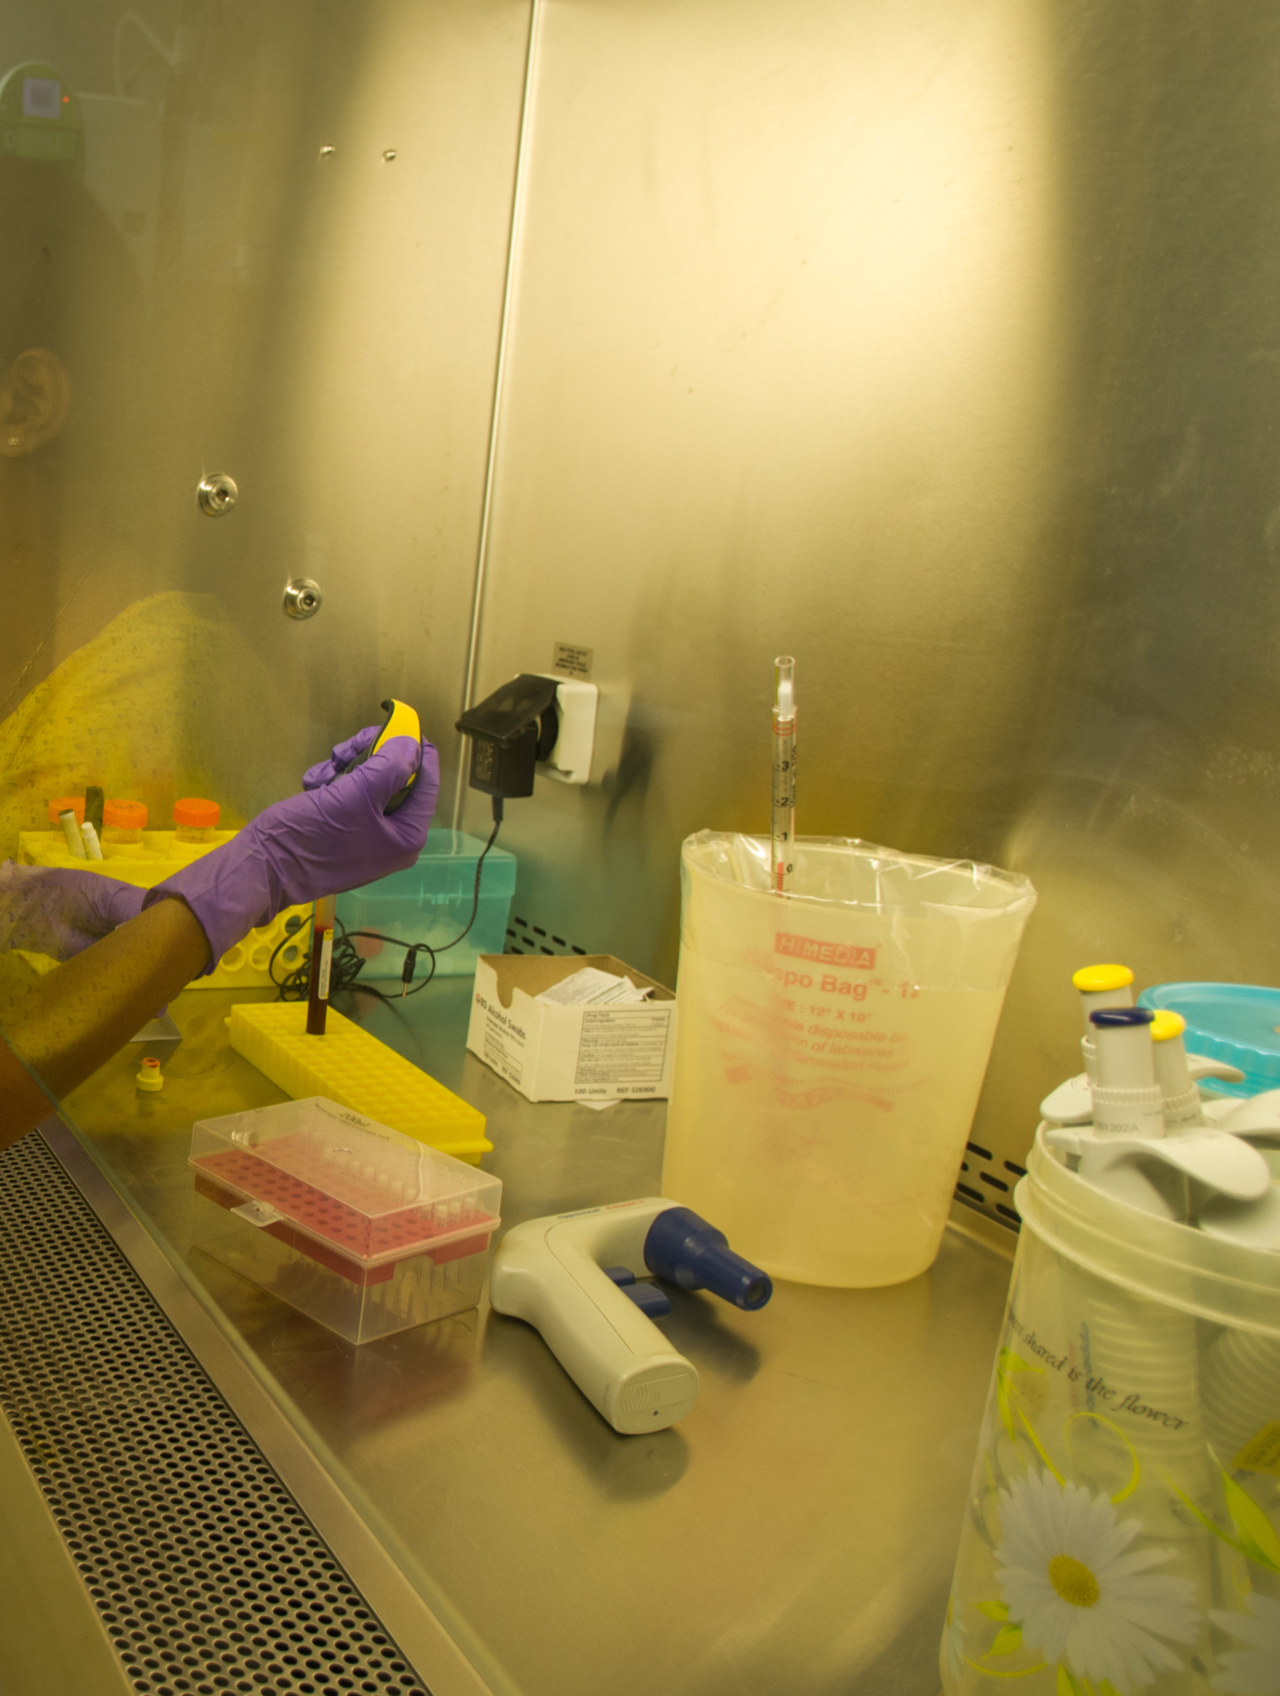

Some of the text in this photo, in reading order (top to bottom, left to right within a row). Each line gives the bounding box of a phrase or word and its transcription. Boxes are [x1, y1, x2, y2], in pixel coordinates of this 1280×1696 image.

[779, 936, 872, 966] HIMEDIA
[487, 1003, 507, 1026] Alcohol
[507, 1019, 526, 1040] Swabs
[807, 1023, 887, 1043] disposable
[588, 1087, 607, 1095] Units
[616, 1086, 629, 1094] REF
[1023, 1331, 1068, 1372] shared
[1067, 1366, 1082, 1382] is
[1085, 1377, 1117, 1400] the
[1110, 1393, 1190, 1431] flower
